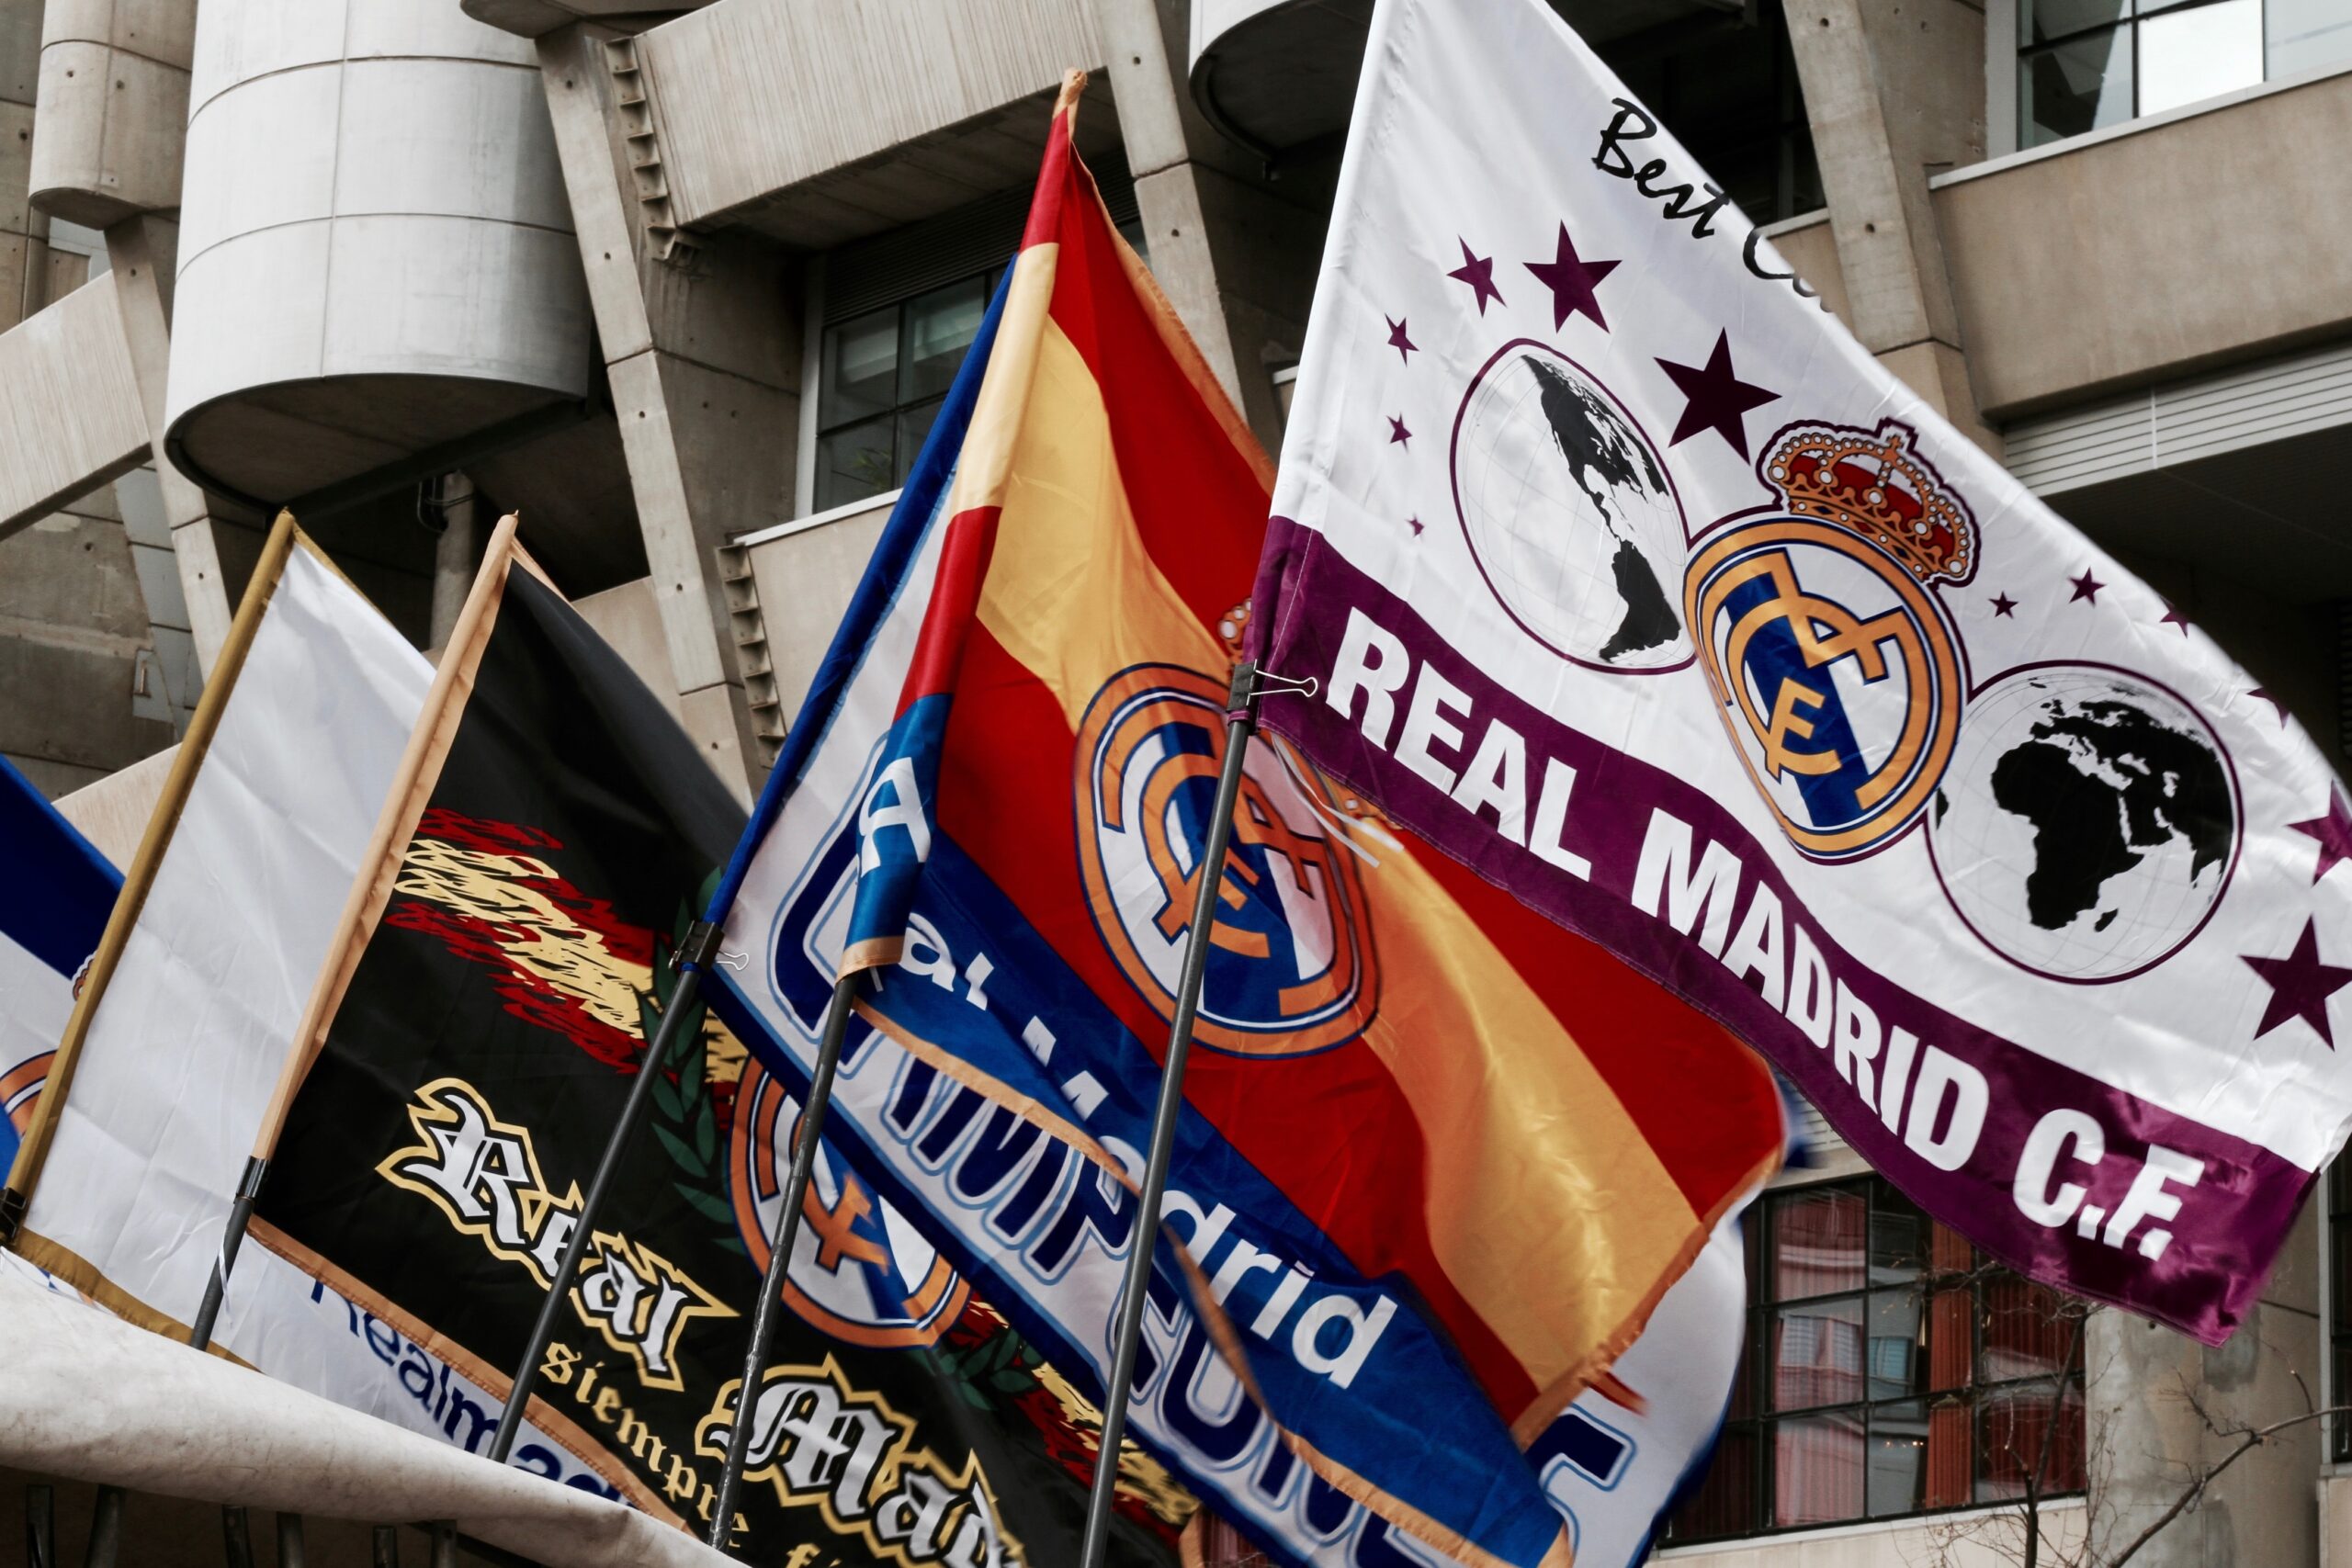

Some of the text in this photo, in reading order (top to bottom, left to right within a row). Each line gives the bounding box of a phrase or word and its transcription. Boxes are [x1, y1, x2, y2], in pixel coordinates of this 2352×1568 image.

[1591, 97, 1730, 239] Best
[1326, 605, 1591, 882] REAL
[1632, 807, 1989, 1171] MADRID
[2013, 1108, 2205, 1261] C.F.
